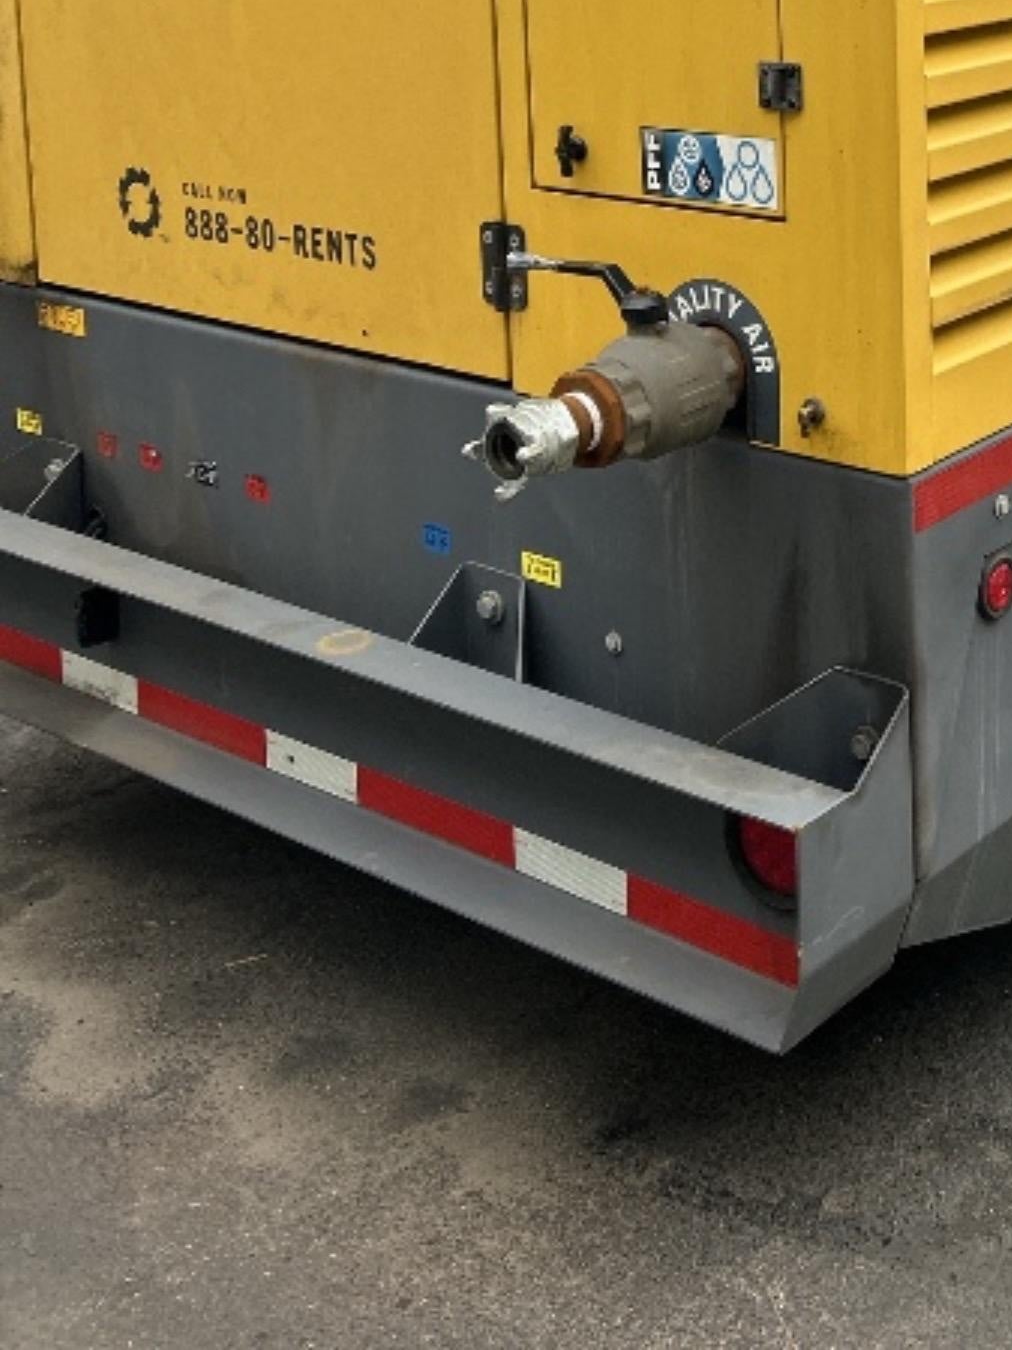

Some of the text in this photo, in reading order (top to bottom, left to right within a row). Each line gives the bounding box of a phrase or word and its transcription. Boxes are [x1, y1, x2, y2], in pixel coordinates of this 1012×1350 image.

[184, 206, 377, 271] 888-80-RENTS
[668, 284, 775, 373] ALITY AIR
